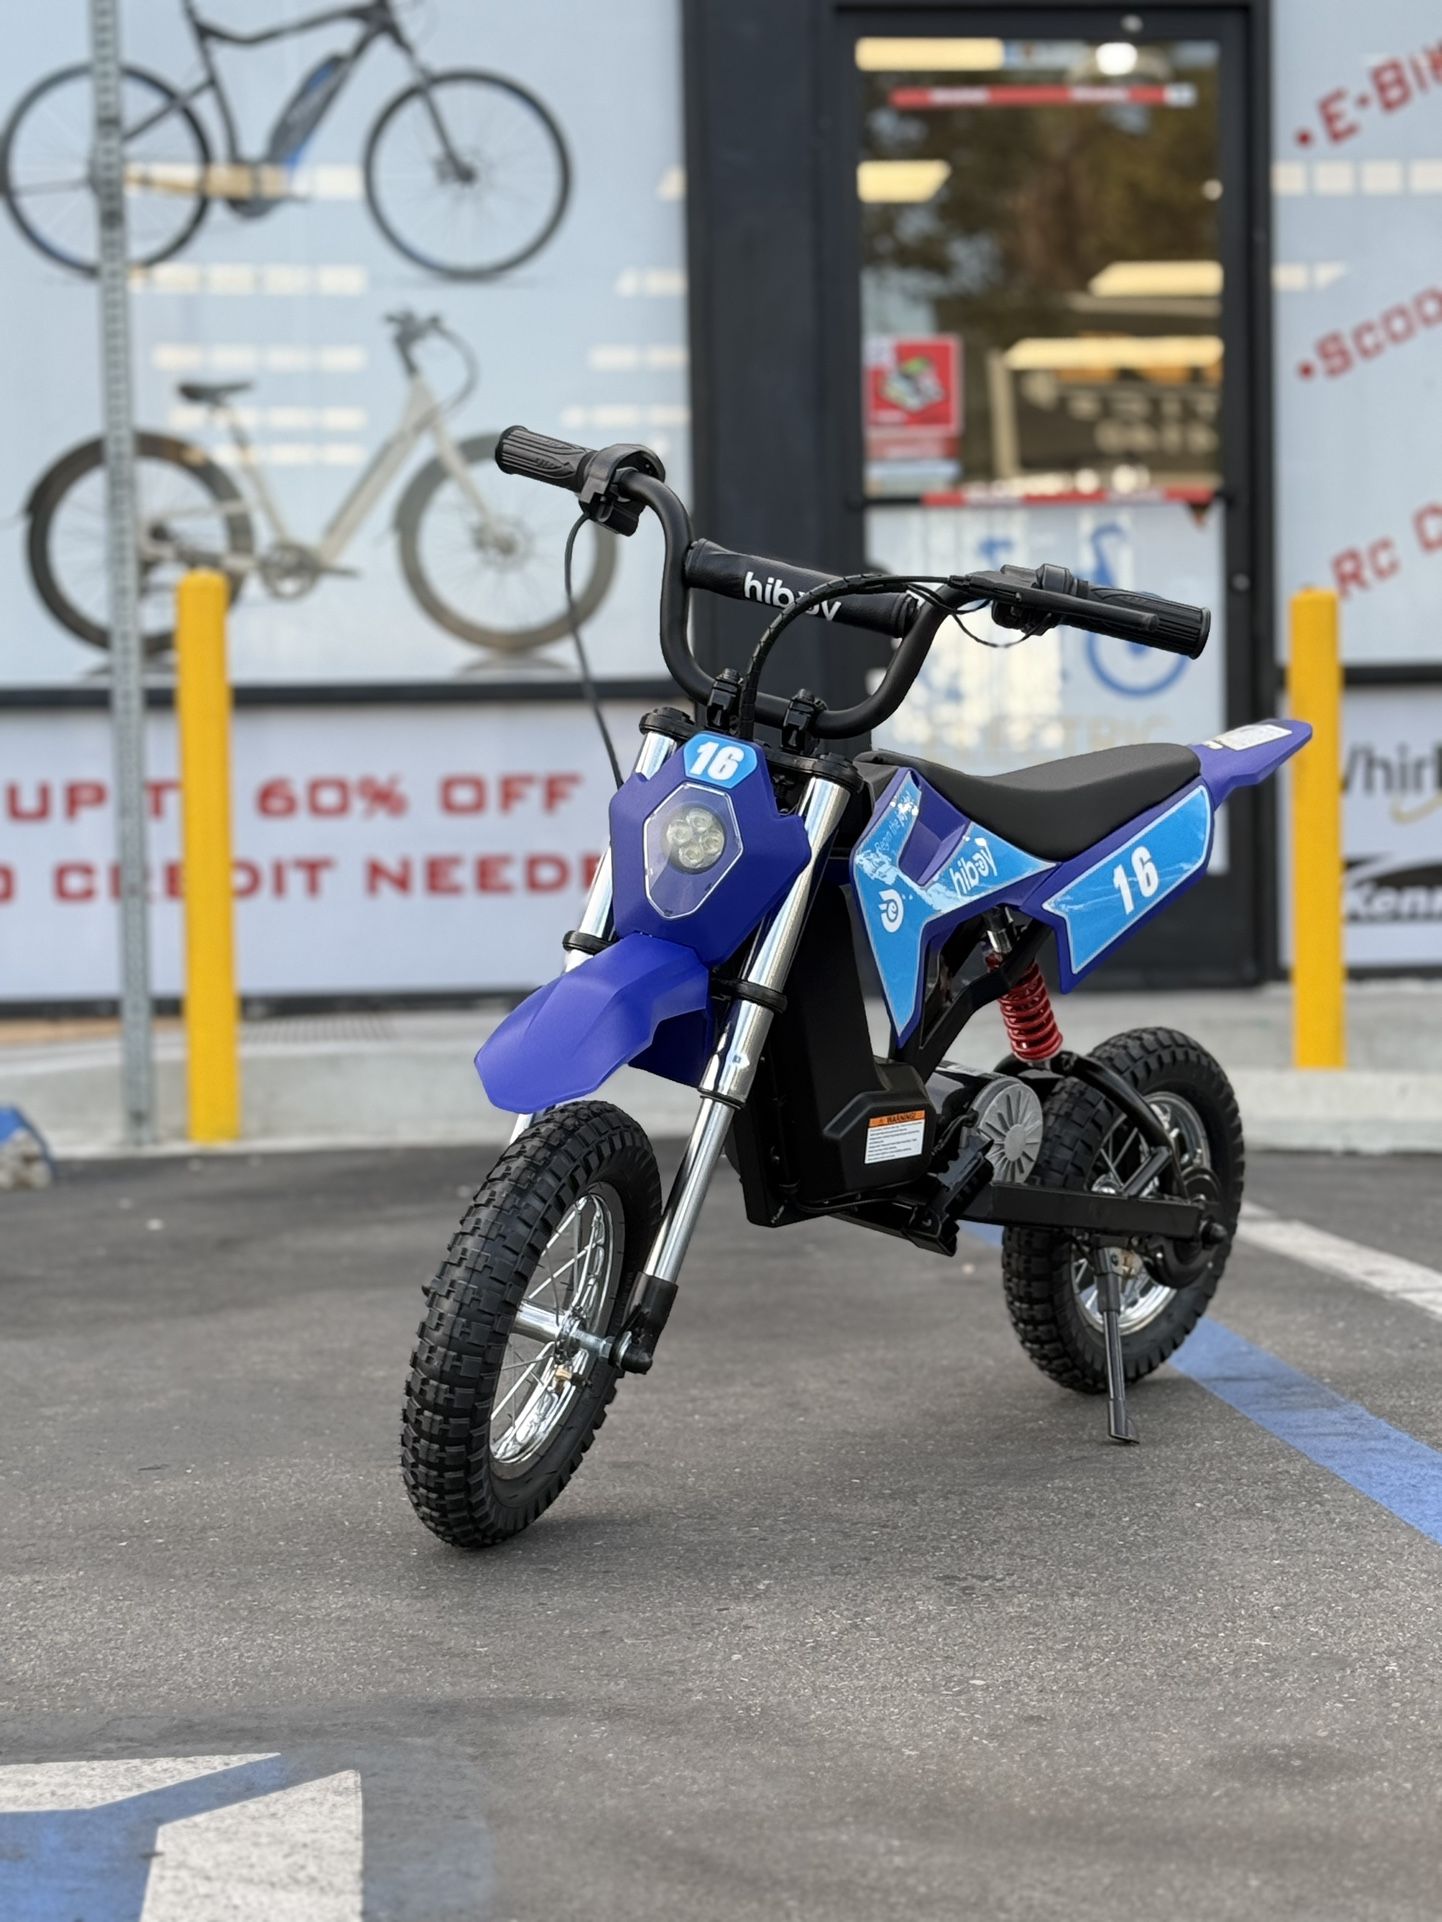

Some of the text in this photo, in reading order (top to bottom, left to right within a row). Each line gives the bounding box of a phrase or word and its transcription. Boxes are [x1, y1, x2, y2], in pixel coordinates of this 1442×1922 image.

[744, 571, 842, 621] hiby
[689, 741, 745, 781] 16
[1341, 743, 1442, 795] hirl
[6, 772, 583, 823] UP T 60% OFF
[54, 857, 336, 902] CDIT
[1113, 846, 1159, 915] 16
